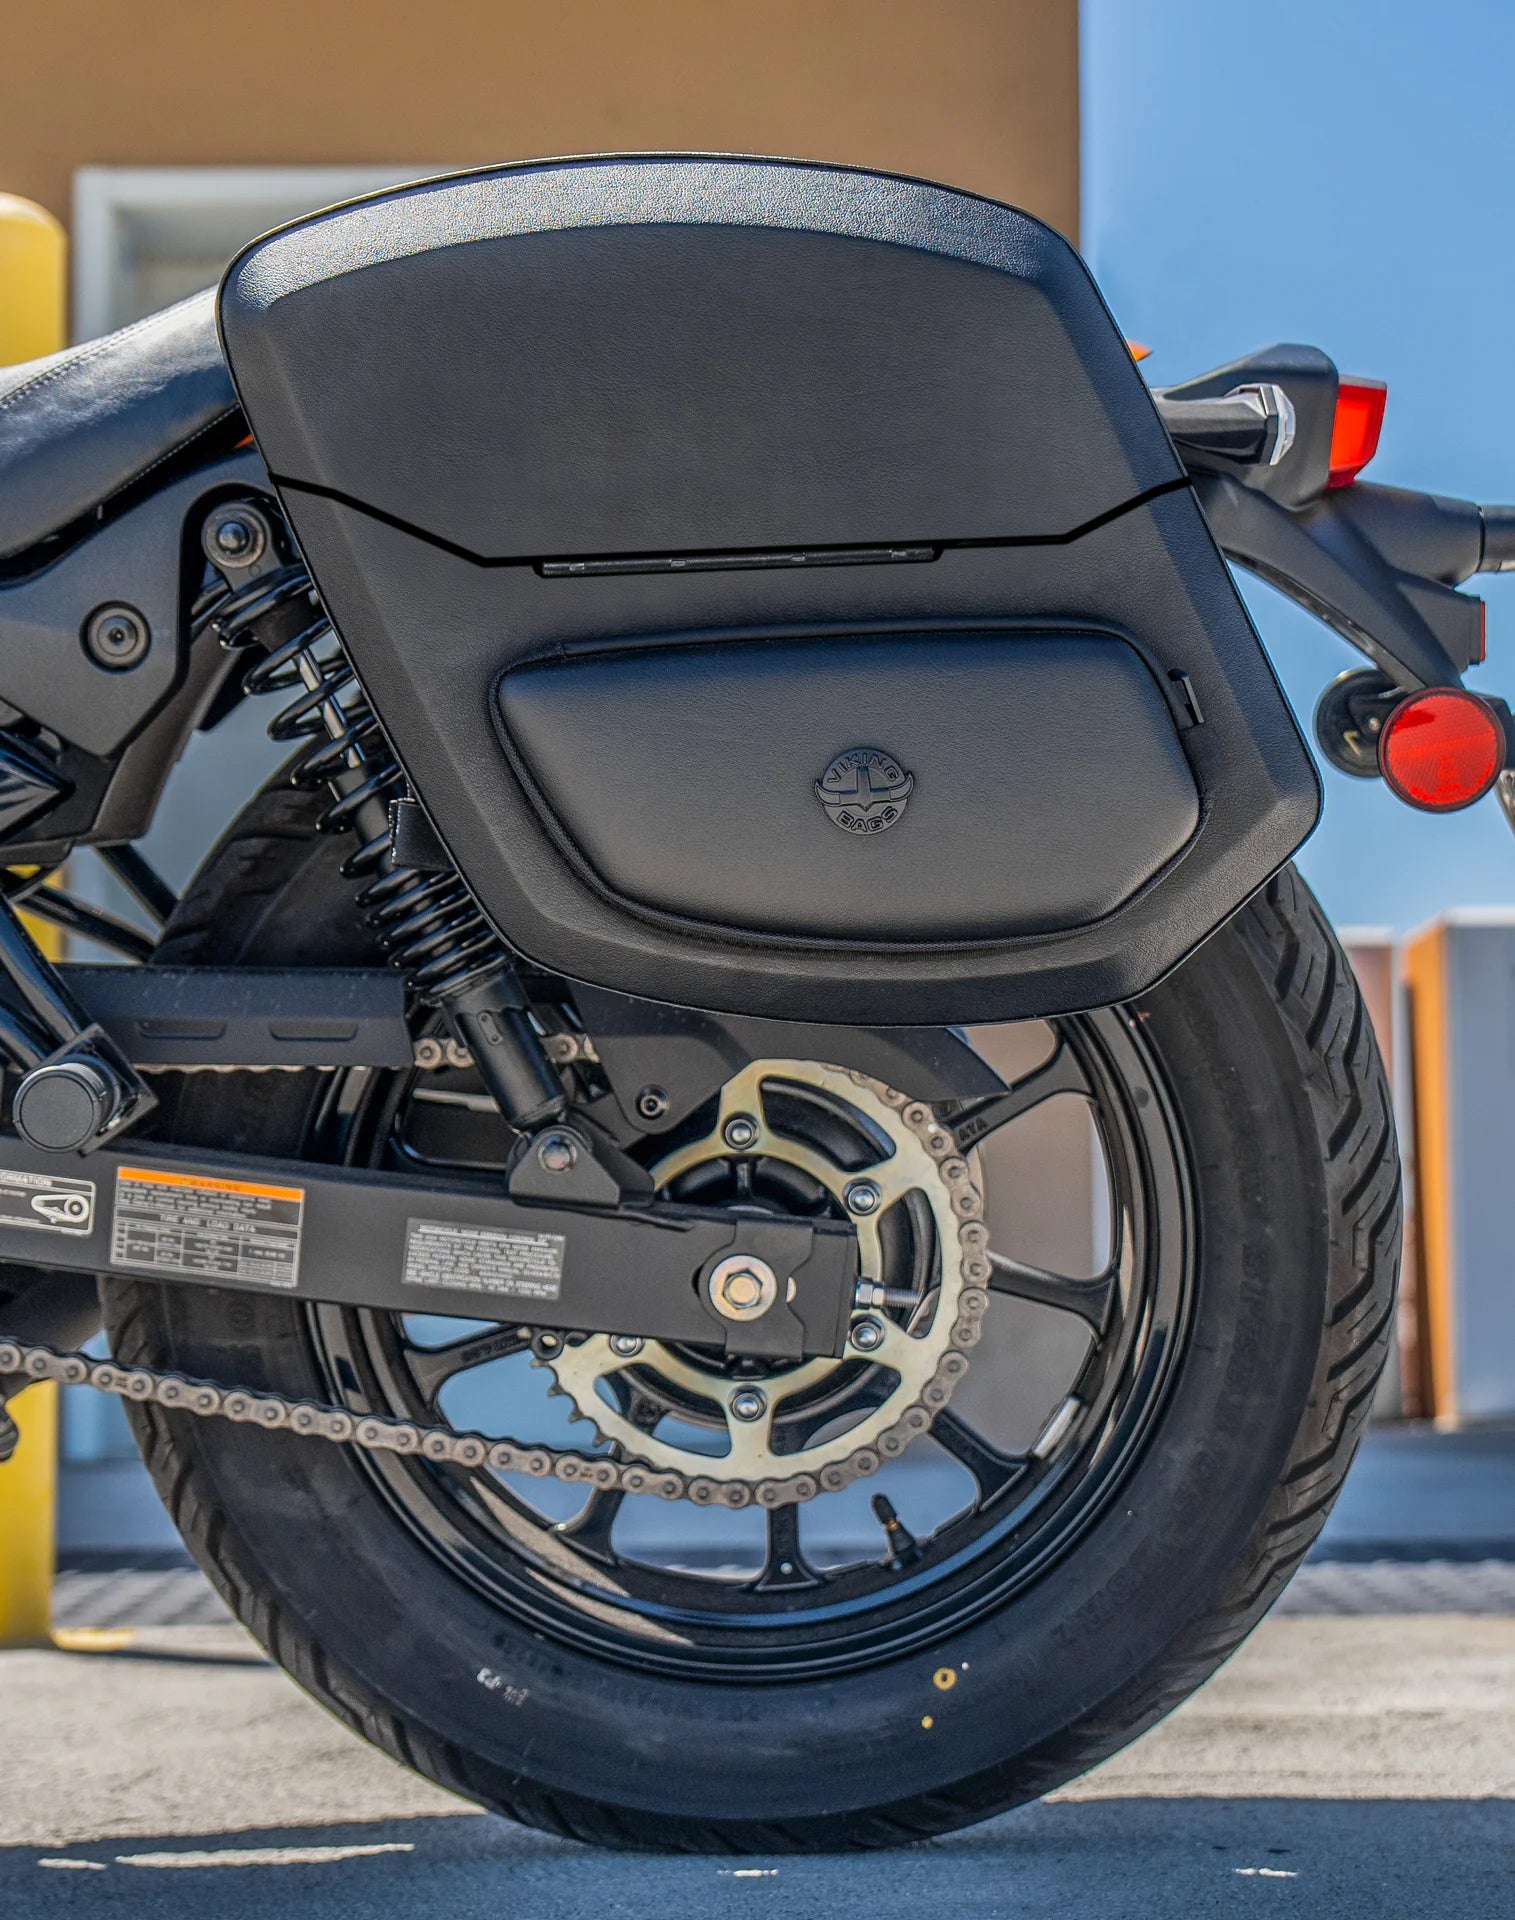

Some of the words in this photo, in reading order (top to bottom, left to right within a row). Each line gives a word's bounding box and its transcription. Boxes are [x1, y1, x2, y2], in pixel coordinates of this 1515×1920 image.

[827, 752, 899, 783] VIKING
[836, 805, 898, 832] BAGS
[233, 1223, 257, 1234] DATA
